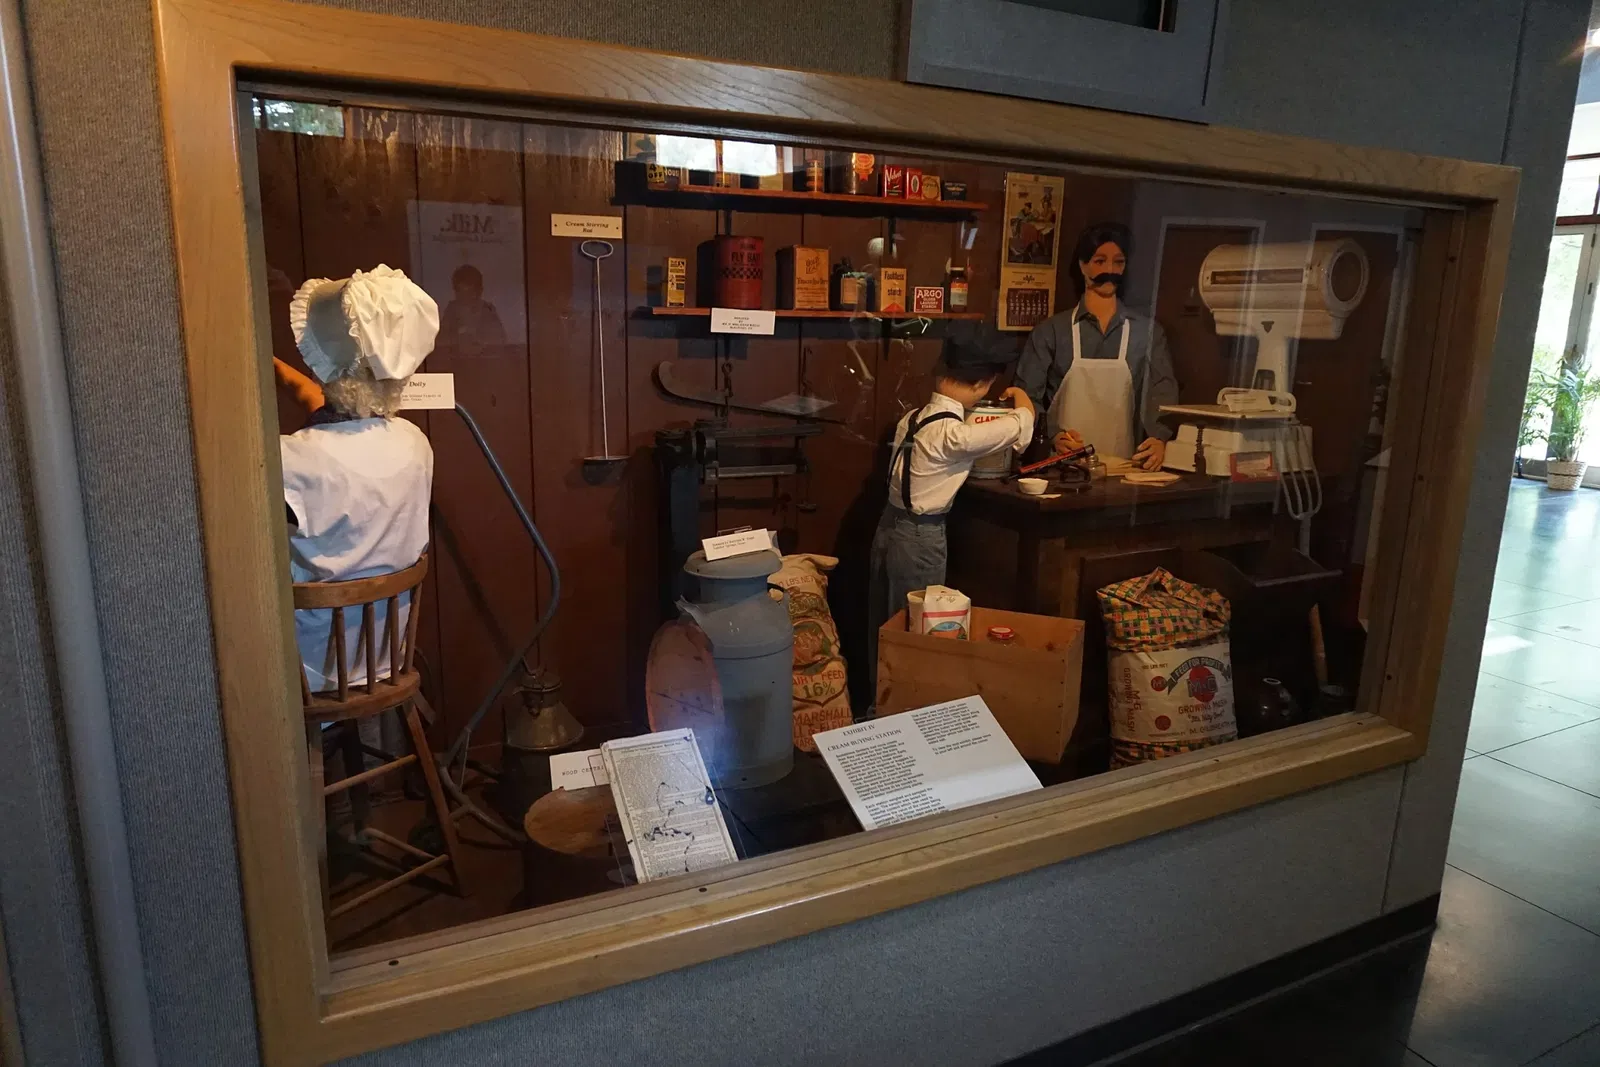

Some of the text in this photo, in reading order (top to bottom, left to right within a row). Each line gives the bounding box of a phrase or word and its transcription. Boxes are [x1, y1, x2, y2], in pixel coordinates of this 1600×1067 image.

[917, 290, 942, 298] ARGO
[792, 670, 844, 685] AIRY FEED
[803, 681, 835, 698] 16%
[793, 708, 852, 726] MARSHALL
[1178, 704, 1211, 714] GROWING
[1127, 708, 1135, 732] MASH
[843, 726, 867, 736] EXHIBIT
[827, 742, 850, 751] CREAM
[850, 736, 875, 746] BUYING
[875, 729, 902, 739] STATION
